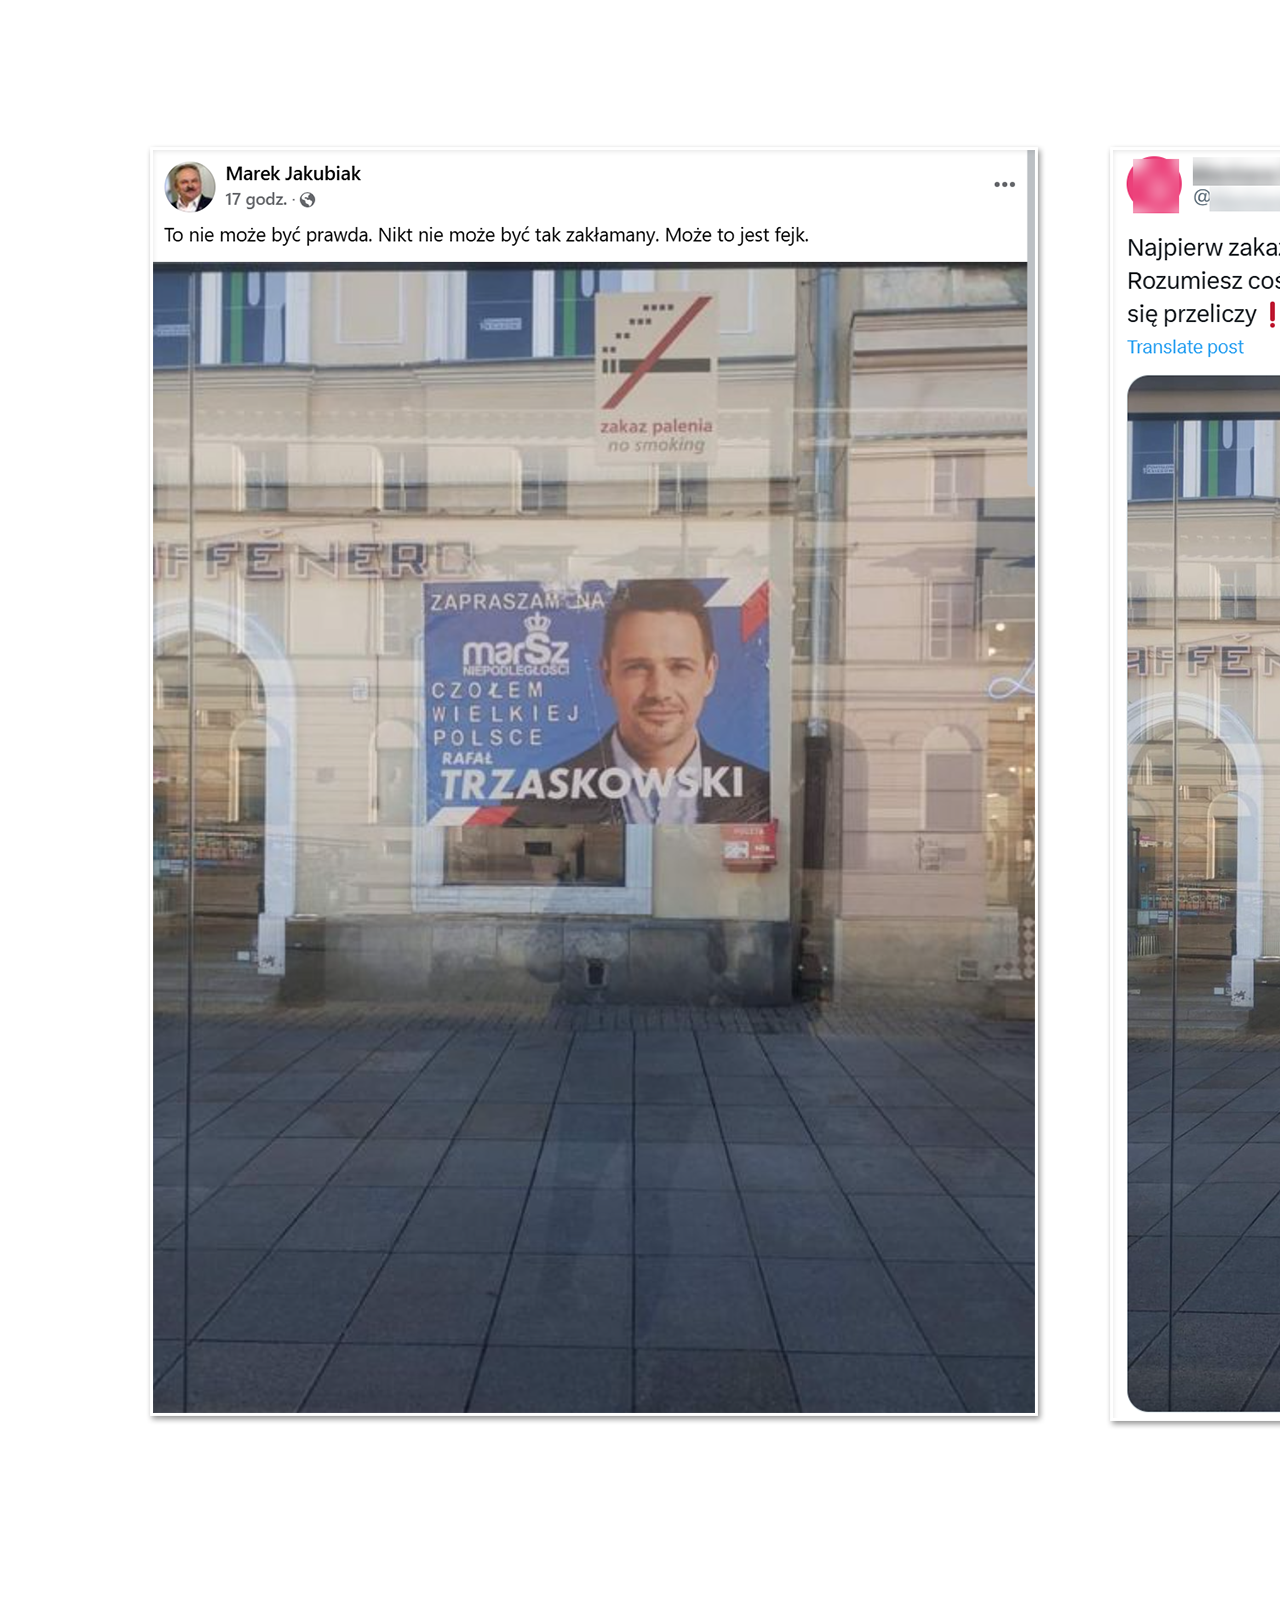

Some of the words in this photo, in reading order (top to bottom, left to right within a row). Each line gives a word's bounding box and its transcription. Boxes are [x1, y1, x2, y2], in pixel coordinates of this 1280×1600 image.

[600, 419, 647, 434] zakaz
[652, 418, 713, 436] palenia
[608, 440, 629, 452] no
[635, 436, 706, 455] smoking
[430, 592, 560, 611] ZAPRASZAM
[577, 591, 606, 610] NA
[432, 681, 544, 700] CZOŁEM
[432, 704, 580, 723] WIELKIEJ
[434, 728, 544, 748] POLSCE
[442, 751, 494, 766] RAFAŁ
[440, 766, 744, 801] TRZASKOWSKI
